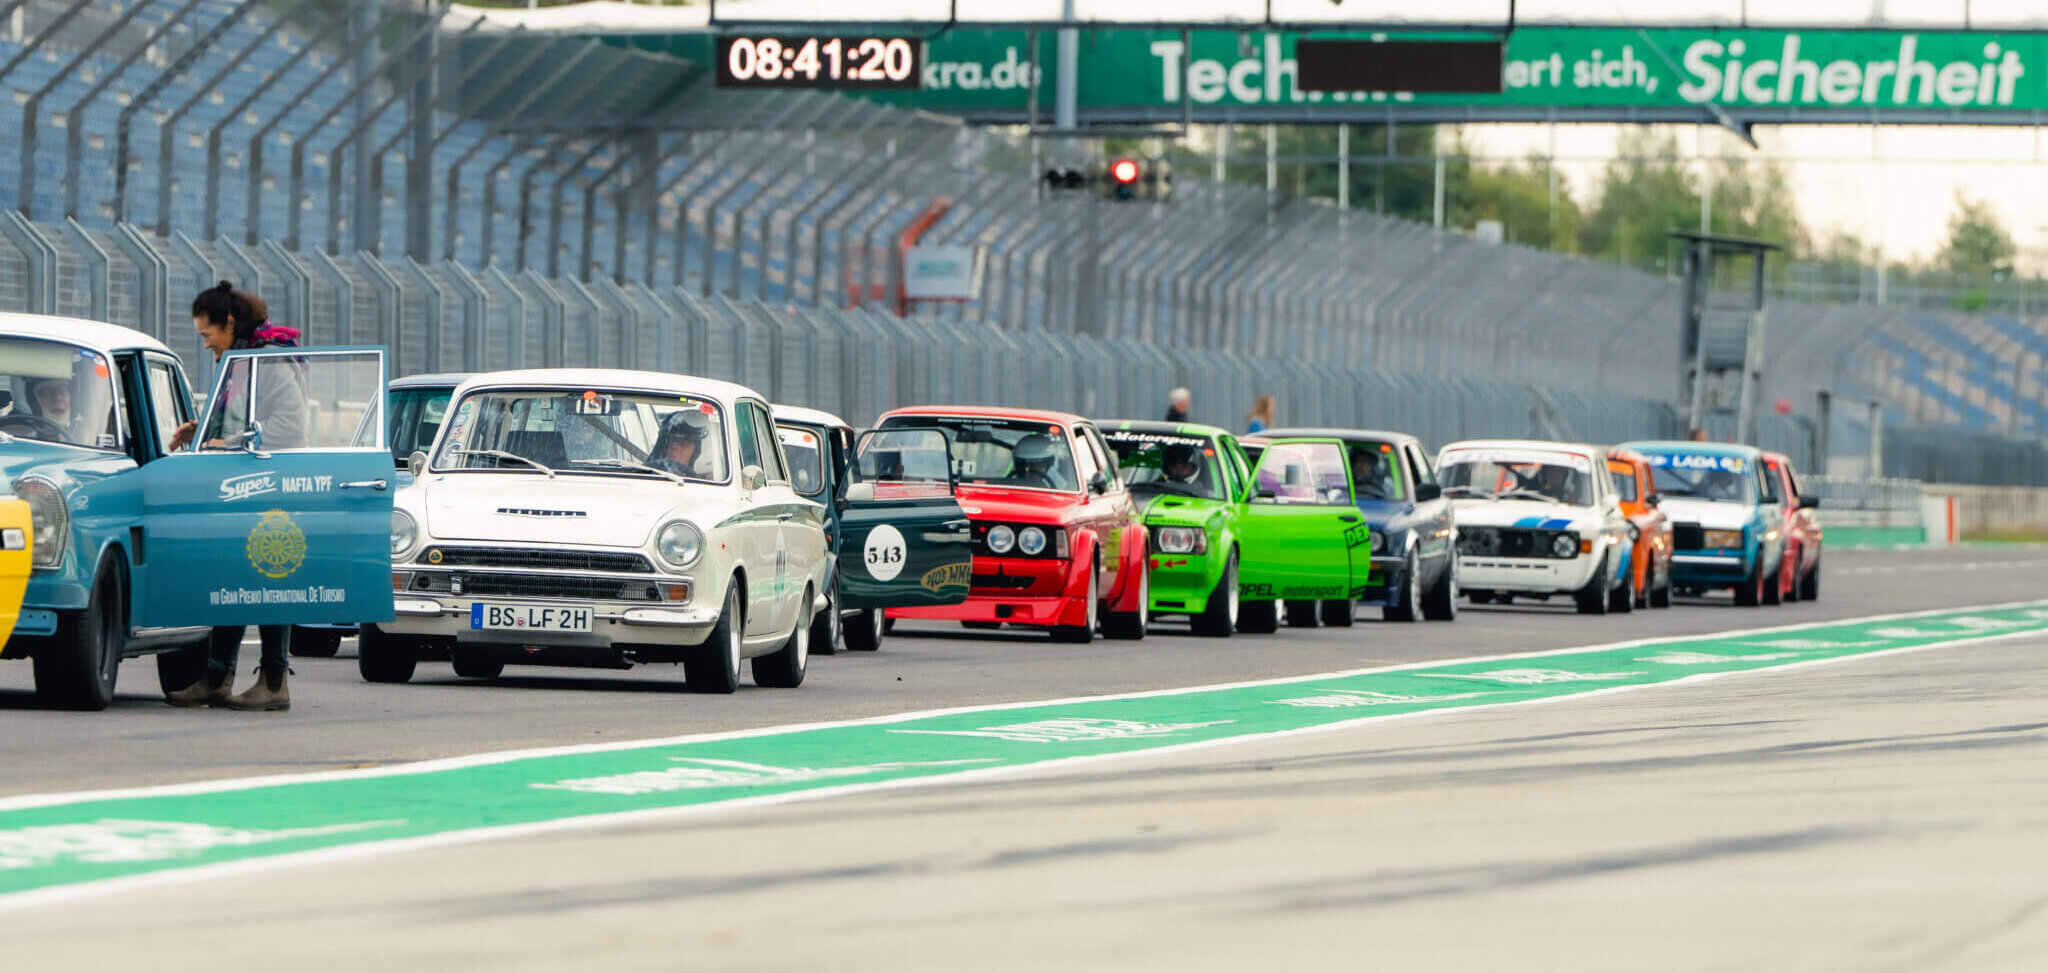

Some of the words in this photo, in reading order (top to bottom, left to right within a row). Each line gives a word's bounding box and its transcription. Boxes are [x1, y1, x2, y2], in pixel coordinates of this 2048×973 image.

[729, 38, 913, 80] 08:41:20
[1150, 33, 1414, 102] Tech
[1573, 45, 1659, 94] sich,
[1678, 34, 2026, 104] Sicherheit
[1672, 455, 1718, 469] LADA
[218, 471, 277, 502] Super
[281, 477, 313, 493] NAFTA
[314, 476, 332, 492] YPF
[868, 546, 902, 564] 543
[489, 607, 516, 626] BS
[529, 609, 555, 628] LF
[559, 610, 587, 629] 2H
